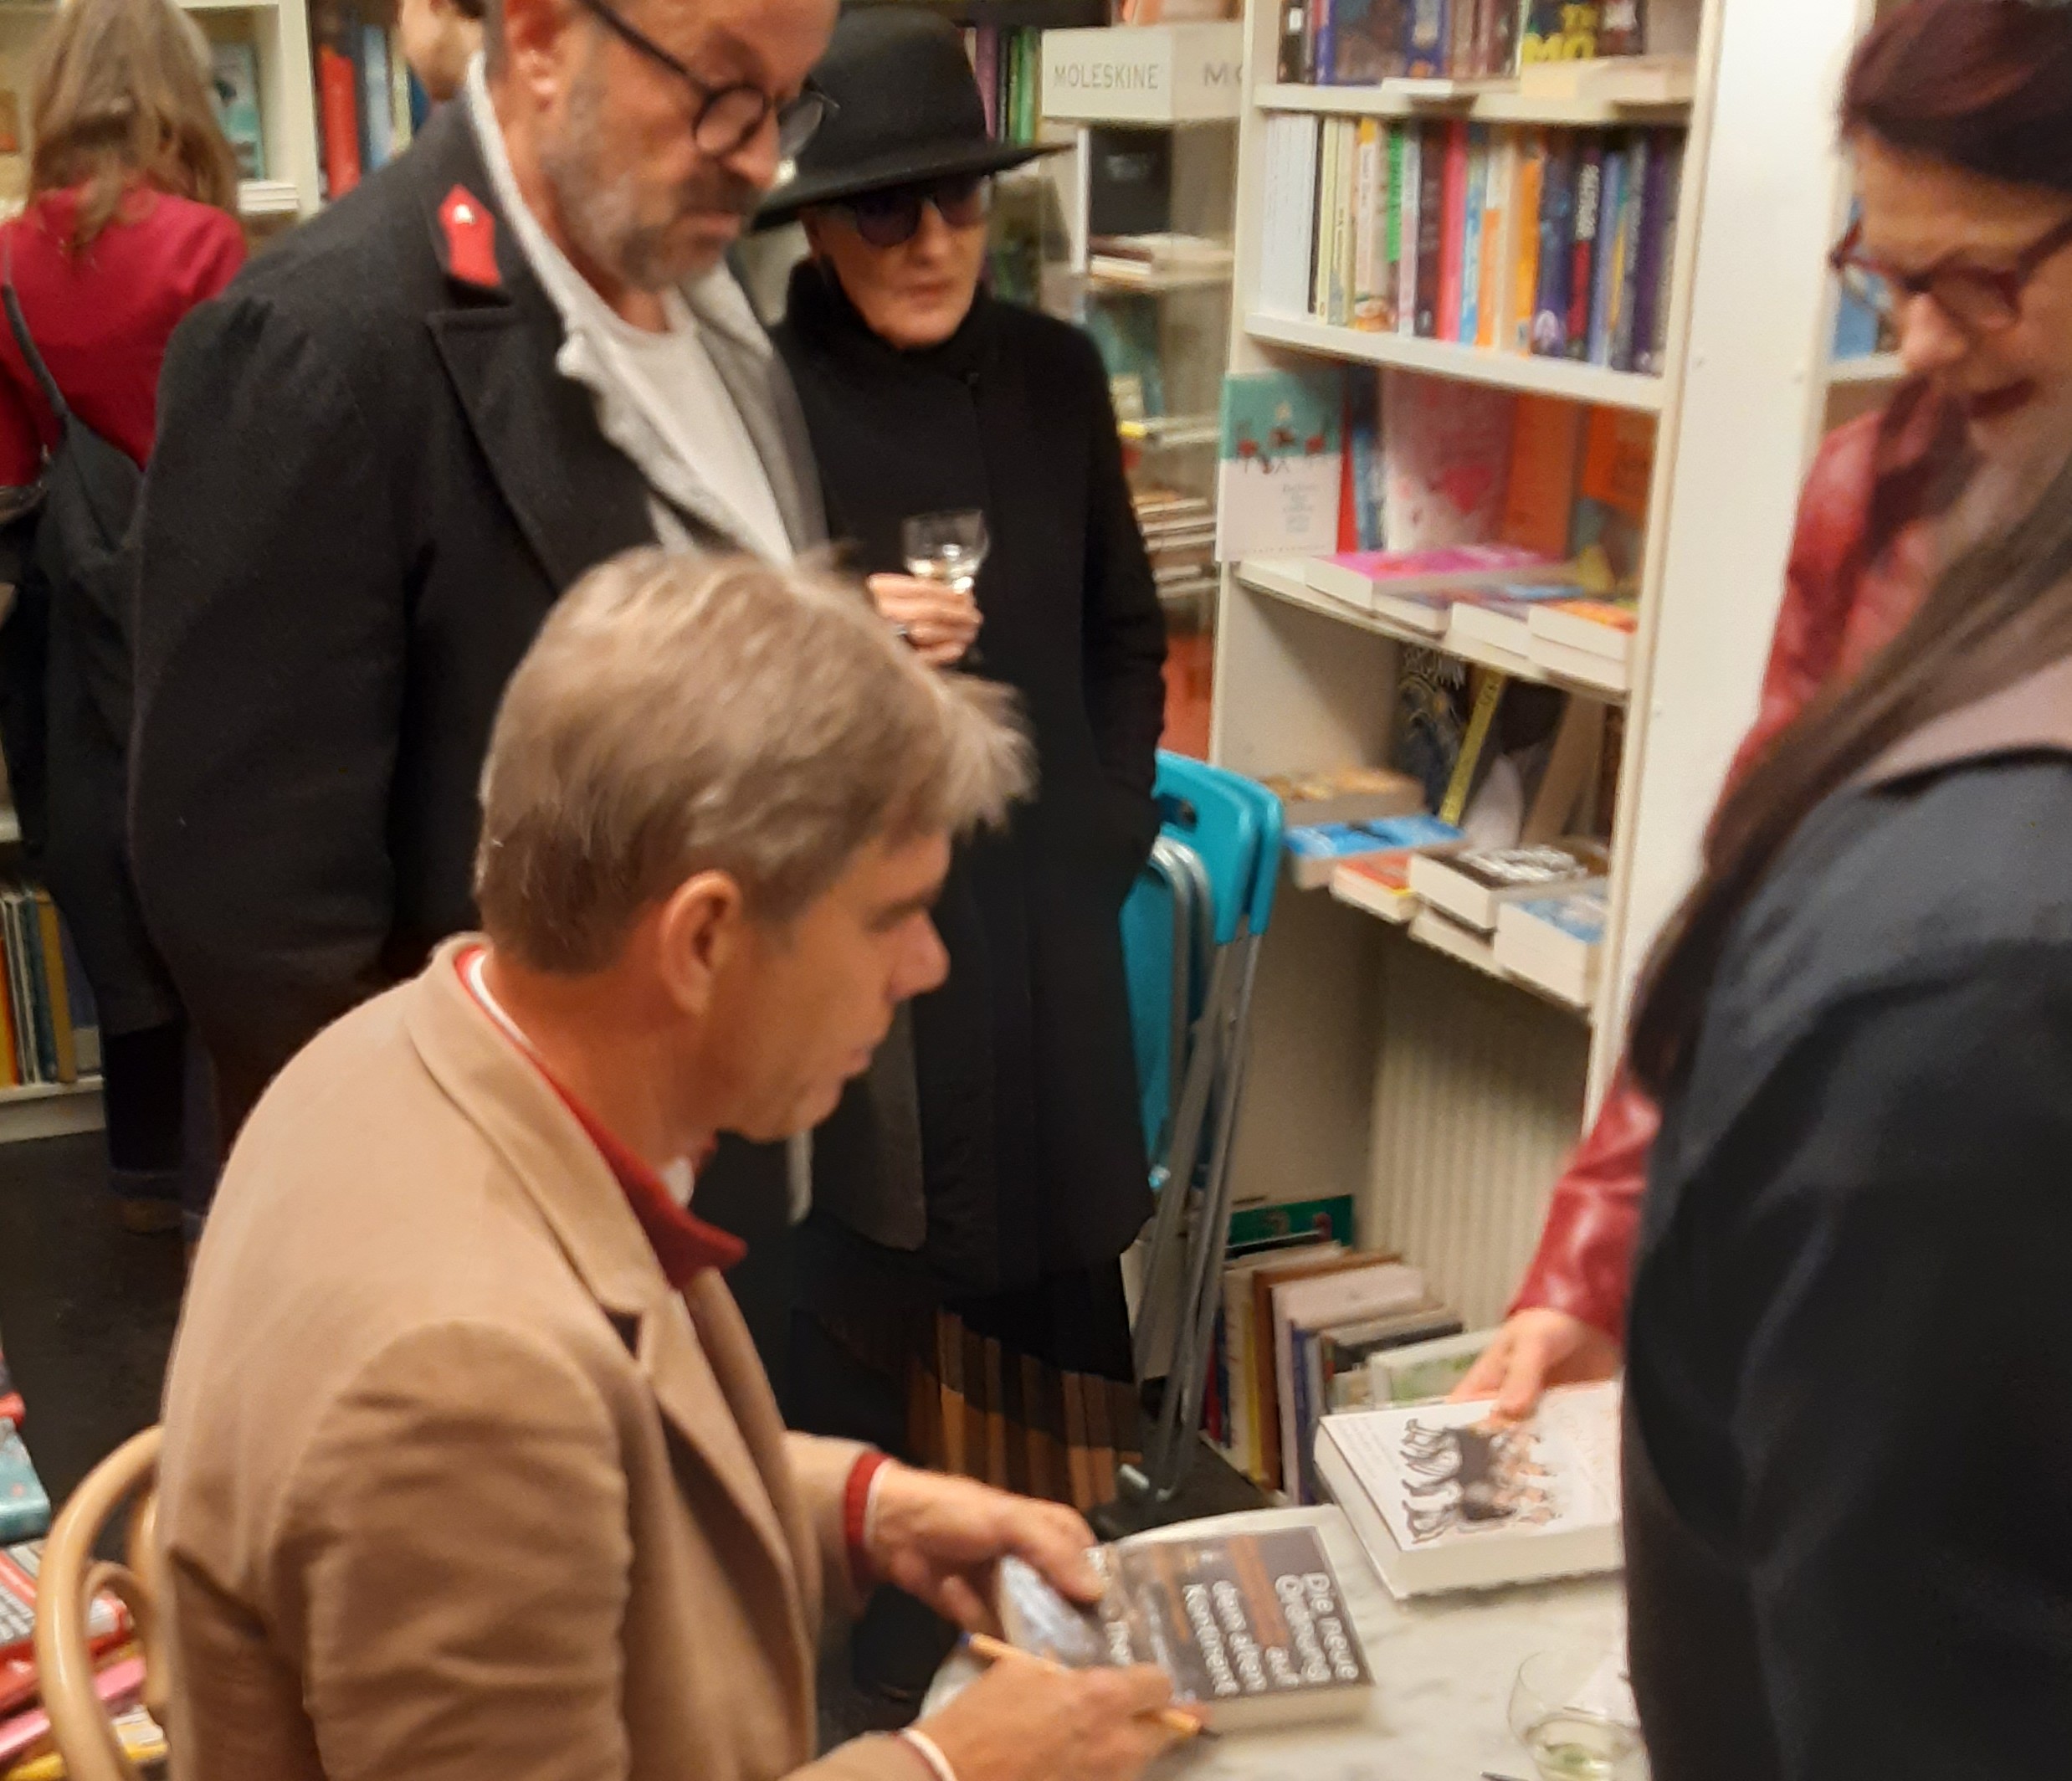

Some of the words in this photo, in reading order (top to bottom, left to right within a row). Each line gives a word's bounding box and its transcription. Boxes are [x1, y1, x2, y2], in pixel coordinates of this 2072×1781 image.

[1053, 62, 1160, 90] MOLESKINE
[1301, 1572, 1336, 1614] Die
[1182, 1583, 1240, 1697] Kontinent
[1275, 1573, 1331, 1683] Ordnung
[1317, 1617, 1359, 1680] neue
[1264, 1646, 1299, 1687] auf
